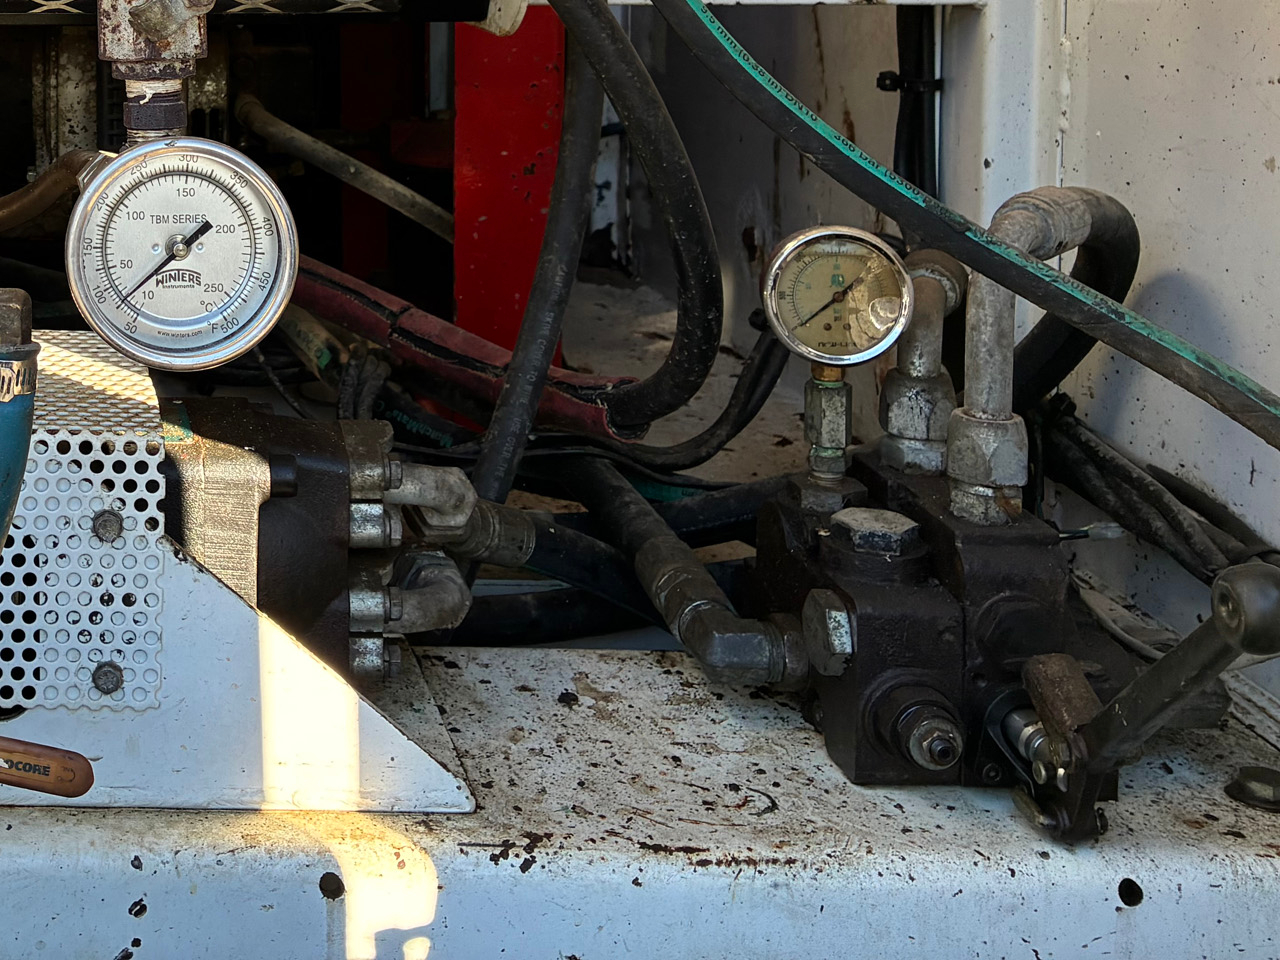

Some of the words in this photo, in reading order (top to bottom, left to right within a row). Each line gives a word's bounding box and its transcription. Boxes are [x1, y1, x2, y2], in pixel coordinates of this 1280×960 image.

[130, 161, 149, 176] 250
[229, 170, 249, 189] 350
[176, 188, 196, 197] 150
[95, 192, 109, 212] 200
[125, 211, 146, 221] 100
[150, 214, 170, 224] TBM
[172, 213, 208, 224] SERIES
[215, 224, 236, 234] 200
[262, 216, 274, 237] 400
[83, 237, 93, 256] 150
[119, 259, 133, 269] 50
[155, 271, 202, 288] WINTERS
[258, 271, 272, 292] 450
[92, 285, 107, 304] 100
[141, 290, 155, 300] 10
[203, 283, 224, 293] 250
[123, 320, 138, 335] 50
[220, 317, 240, 334] 500
[0, 757, 51, 777] OCORE
